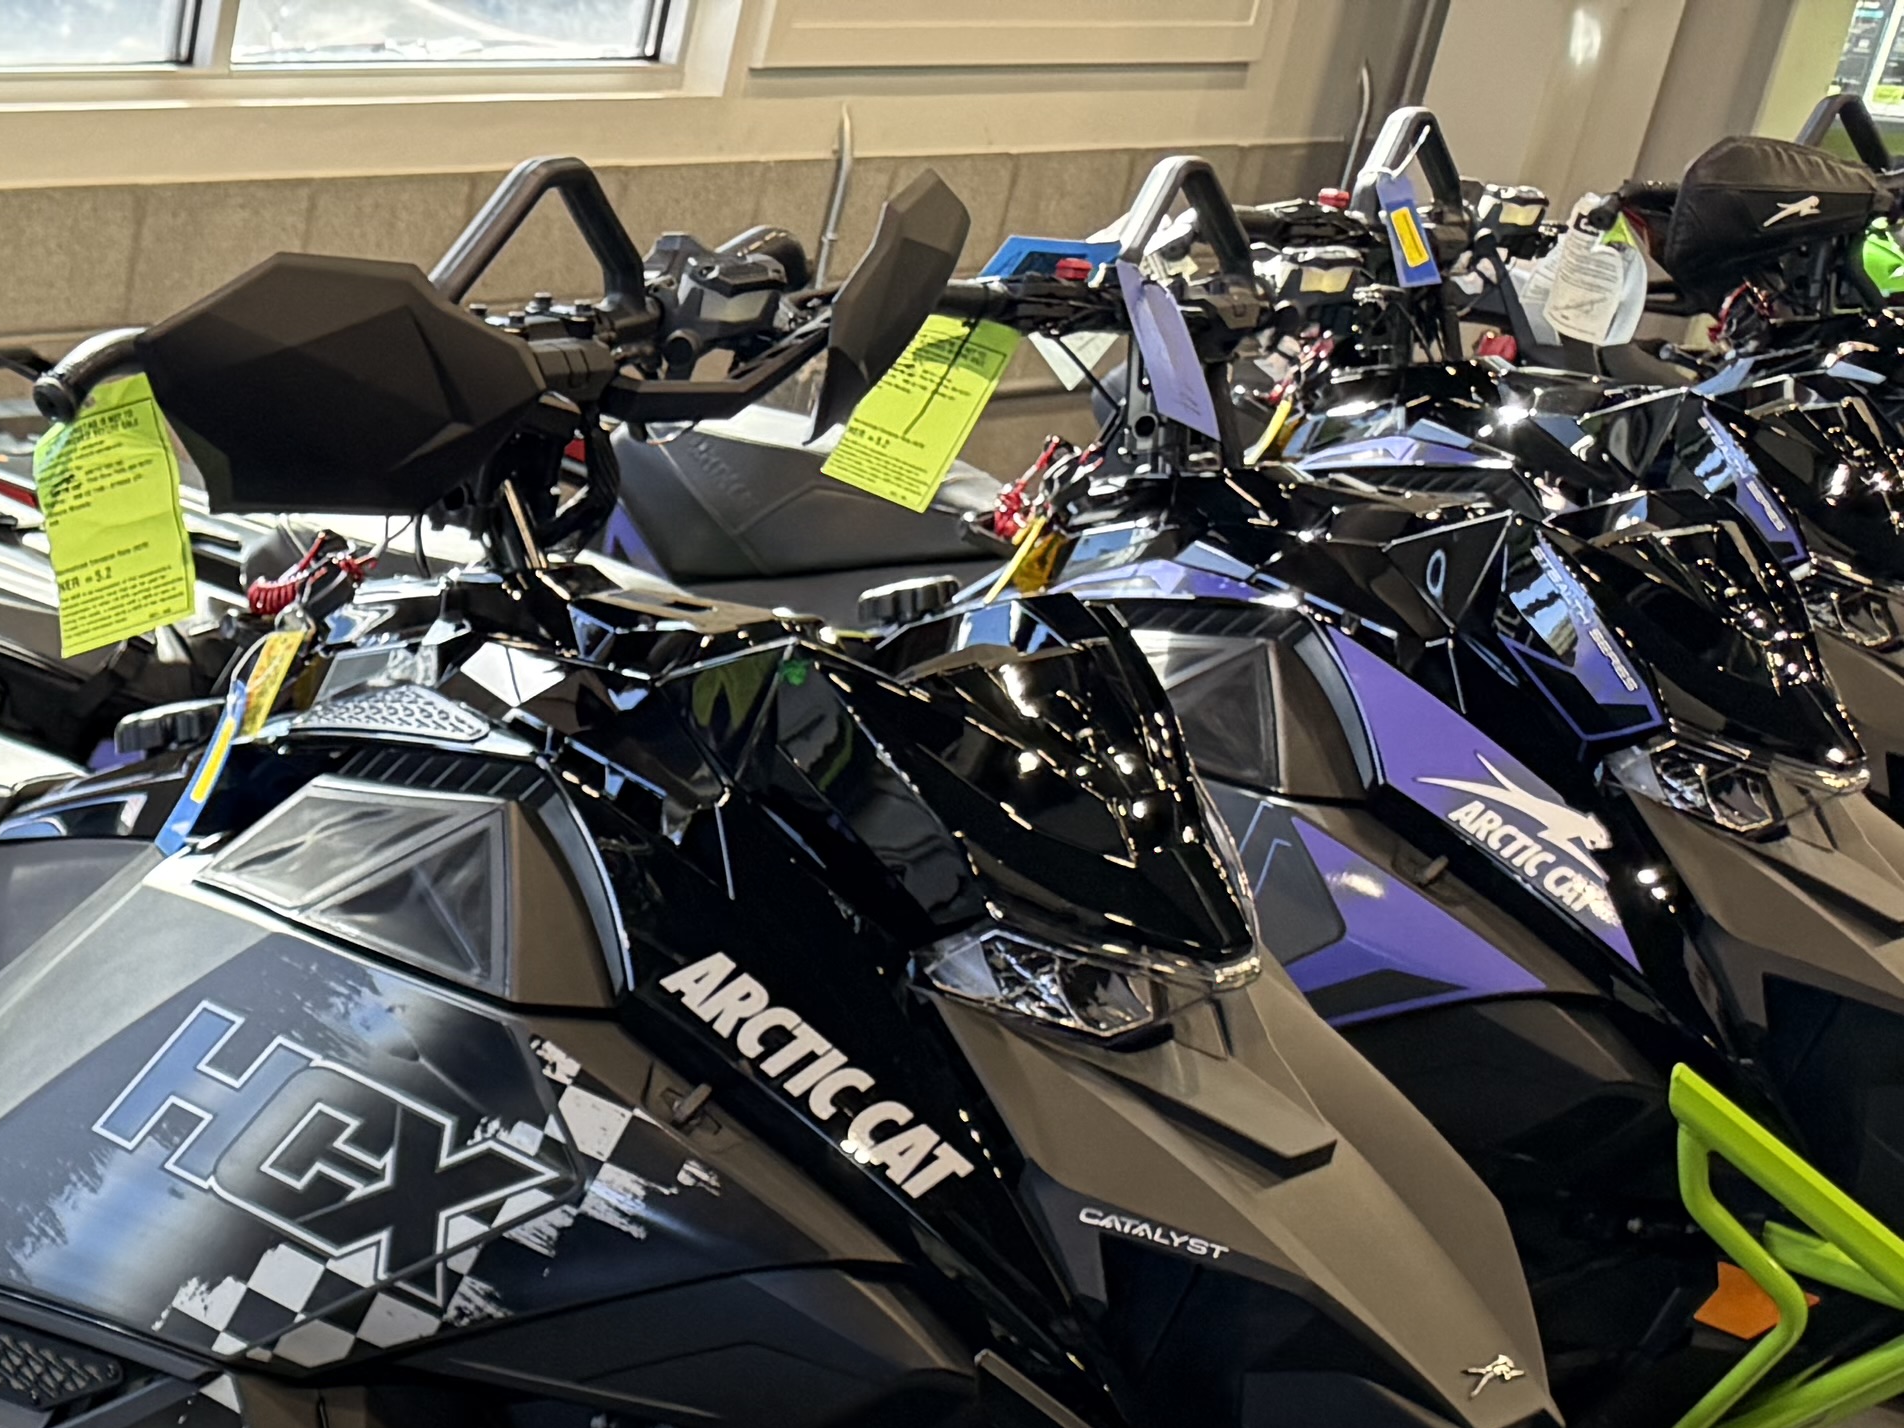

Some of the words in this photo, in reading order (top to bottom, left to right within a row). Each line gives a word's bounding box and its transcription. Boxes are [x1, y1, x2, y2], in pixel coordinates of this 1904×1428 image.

[1448, 800, 1557, 878] ARCTIC
[658, 950, 877, 1122] ARCTIC
[847, 1097, 974, 1200] CAT
[1079, 1206, 1230, 1260] CATALYST
